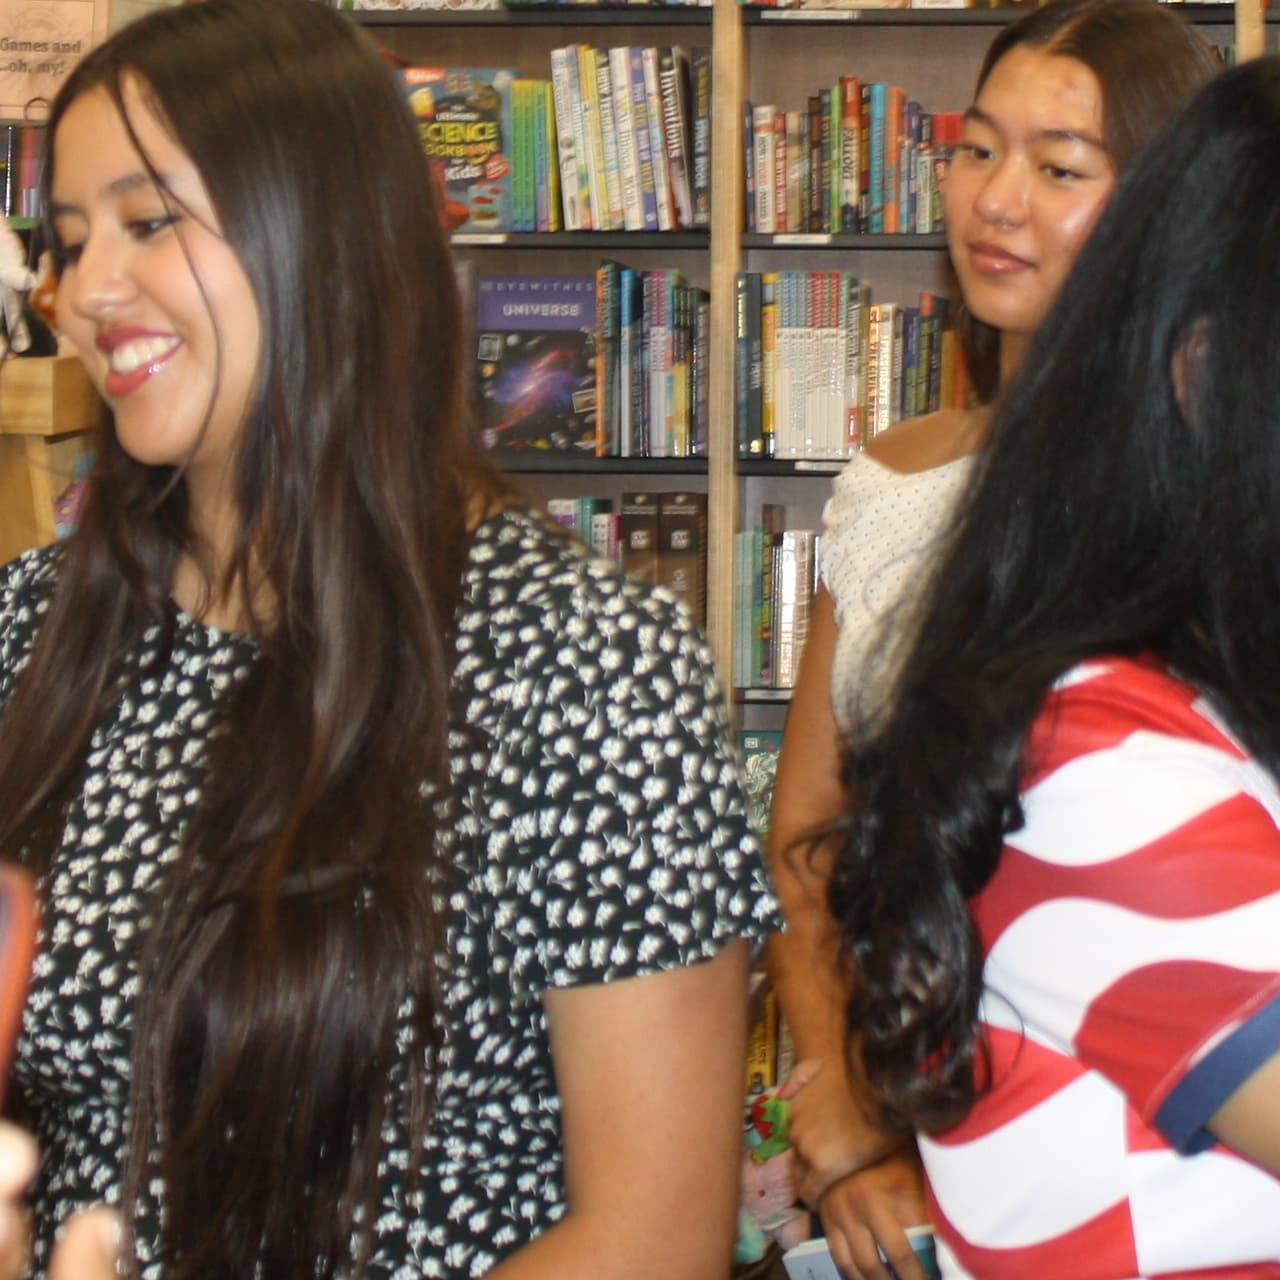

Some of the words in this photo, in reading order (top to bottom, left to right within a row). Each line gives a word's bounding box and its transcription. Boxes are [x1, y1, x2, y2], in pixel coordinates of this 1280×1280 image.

[0, 37, 49, 53] Games
[52, 39, 81, 54] and
[497, 282, 593, 292] EYEWITNES
[503, 303, 580, 317] UNIVERSE
